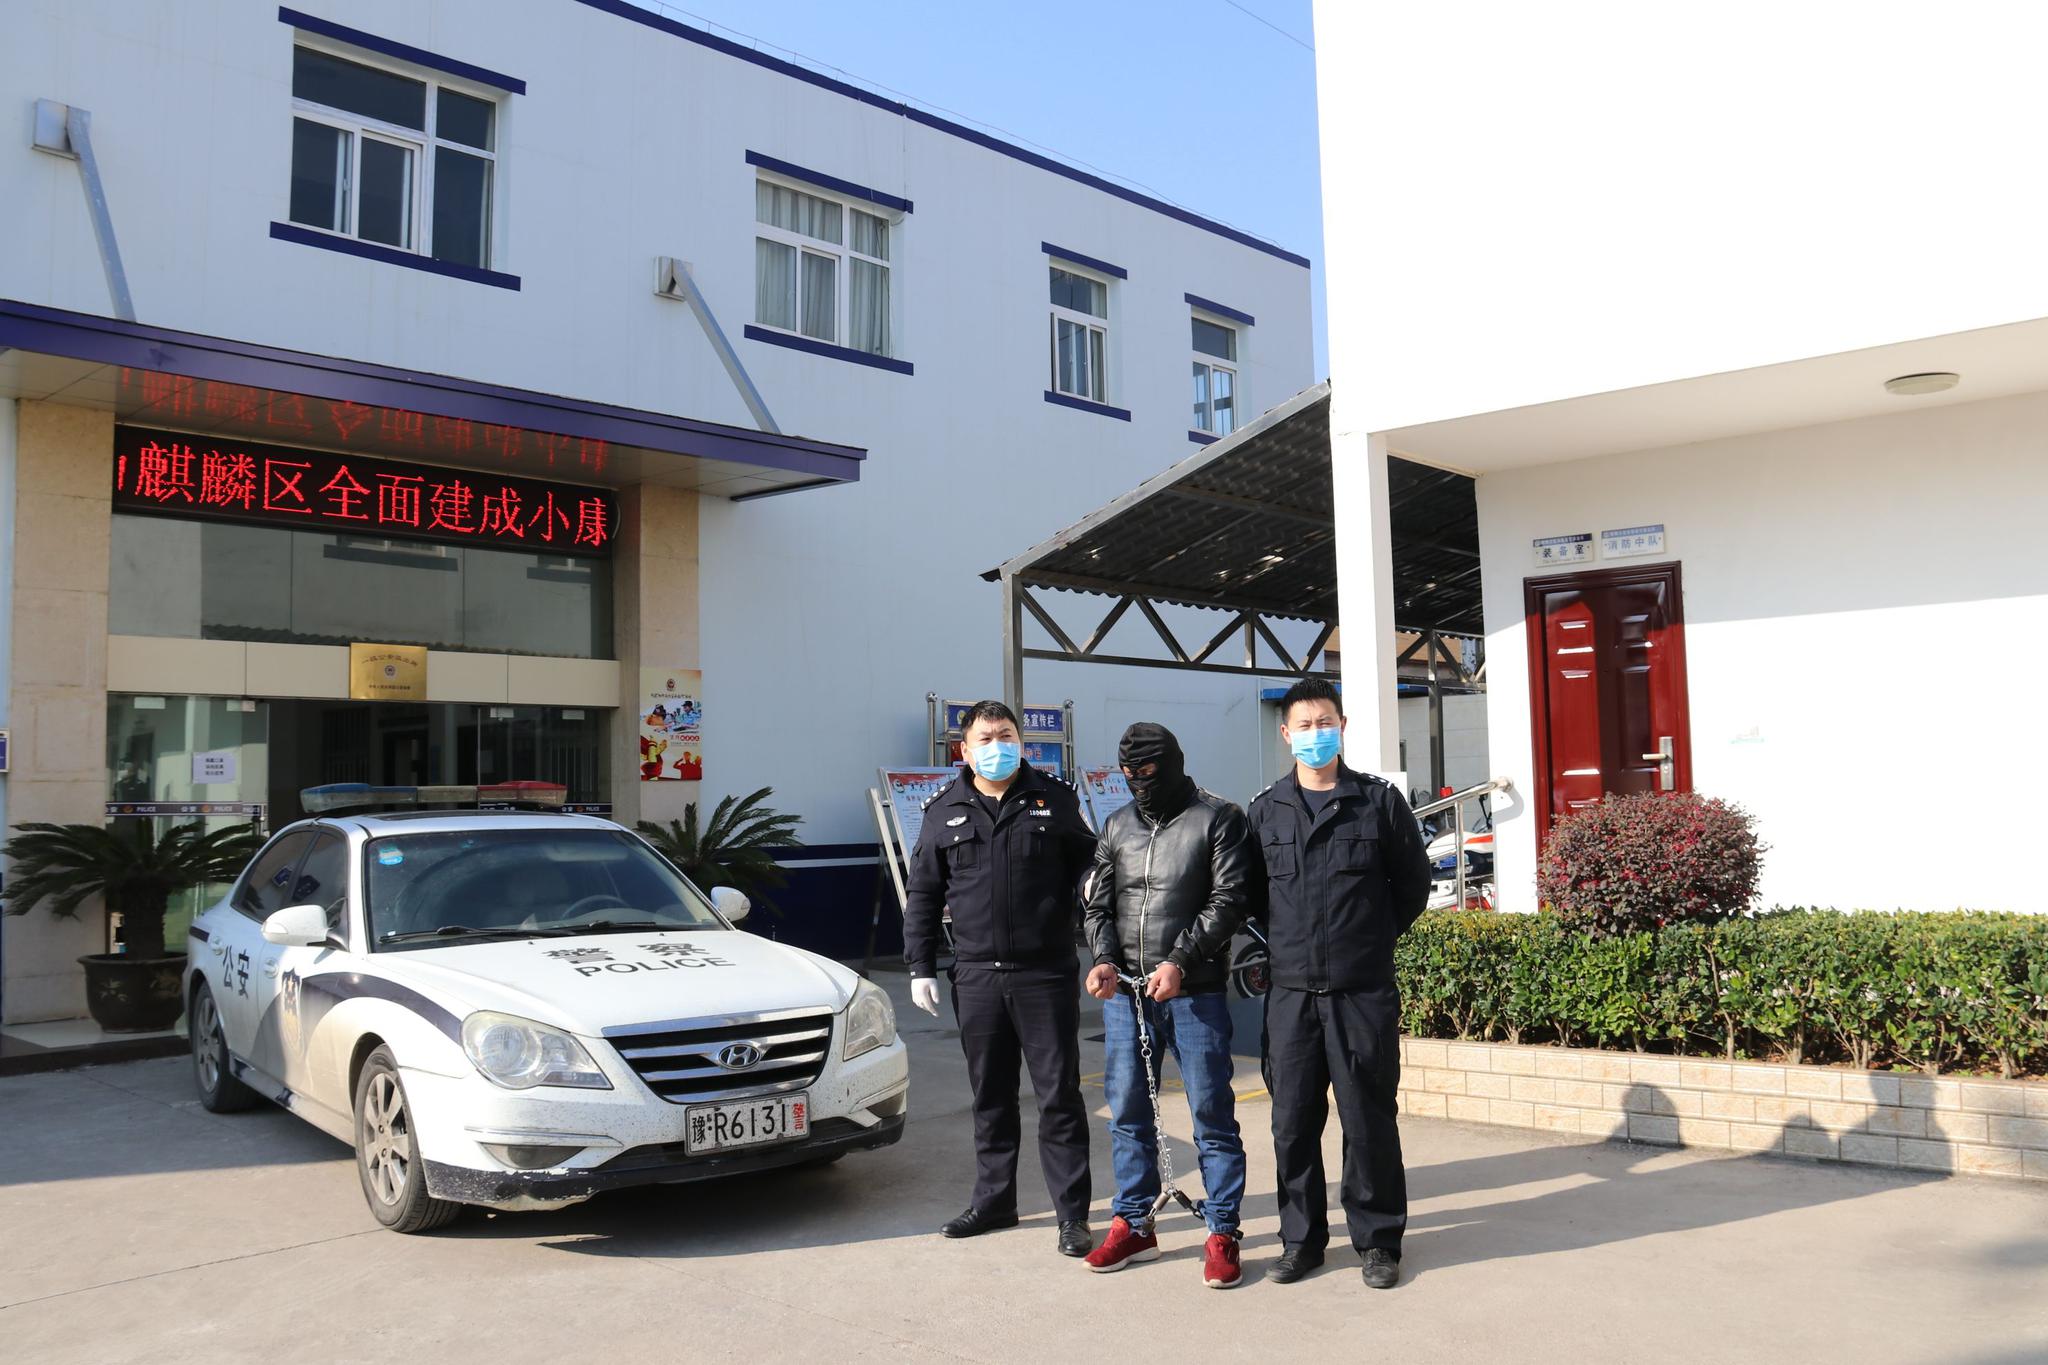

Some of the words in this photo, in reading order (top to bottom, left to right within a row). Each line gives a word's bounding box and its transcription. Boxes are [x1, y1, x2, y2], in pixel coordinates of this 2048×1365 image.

[118, 440, 607, 547] 麒麟区全面建成小康
[1607, 535, 1658, 551] 消防中队
[223, 945, 250, 999] 公安
[575, 957, 737, 978] POLICE
